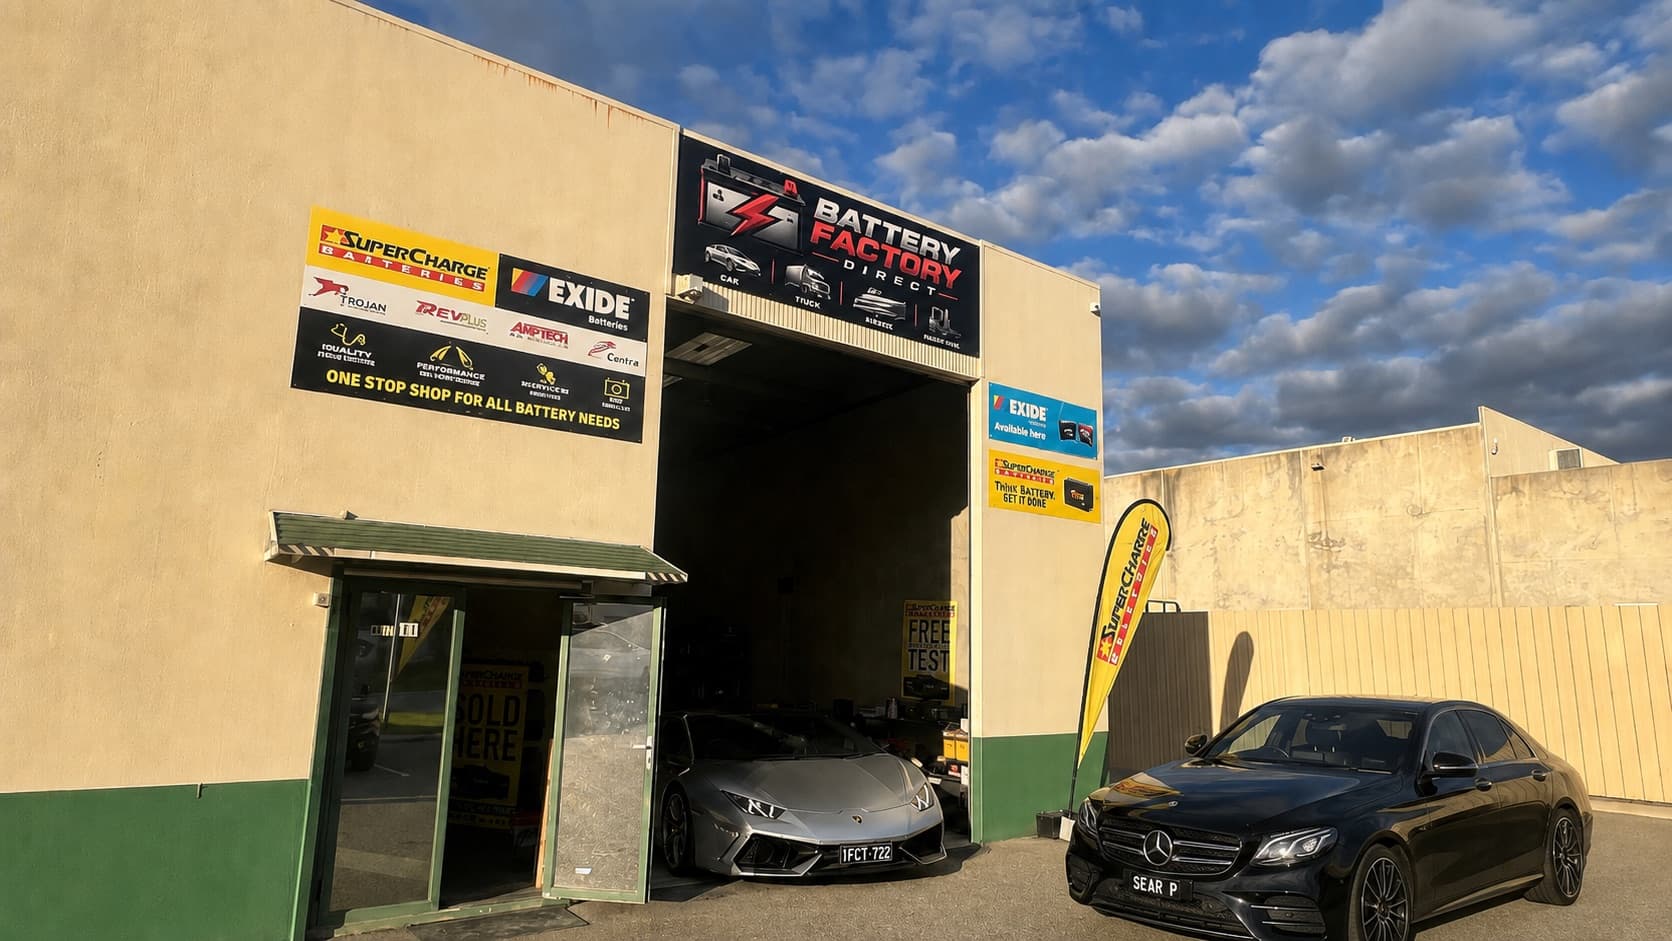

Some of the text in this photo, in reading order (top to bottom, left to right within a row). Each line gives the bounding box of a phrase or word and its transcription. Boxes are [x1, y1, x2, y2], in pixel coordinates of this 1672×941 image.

[813, 197, 961, 265] BATTERY
[810, 220, 962, 289] FACTORY
[720, 274, 739, 286] CAR
[843, 259, 937, 296] DIRECT
[340, 294, 387, 312] TROJAN
[548, 277, 631, 320] EXIDE
[511, 321, 568, 345] AMPTECH
[588, 315, 629, 332] Batteries
[607, 352, 639, 368] Centra
[326, 369, 361, 387] ONE
[364, 375, 407, 394] STOP
[409, 383, 451, 401] SHOP
[454, 391, 483, 407] FOR
[485, 396, 512, 412] ALL
[515, 403, 576, 423] BATTERY
[578, 412, 621, 430] NEEDS
[1009, 399, 1047, 422] EXIDE
[994, 422, 1028, 437] Available
[1029, 428, 1046, 440] here
[1003, 493, 1017, 503] GET
[1019, 495, 1025, 504] IT
[909, 619, 950, 644] FREE
[908, 648, 950, 672] TEST
[1132, 875, 1178, 896] SEAR P
